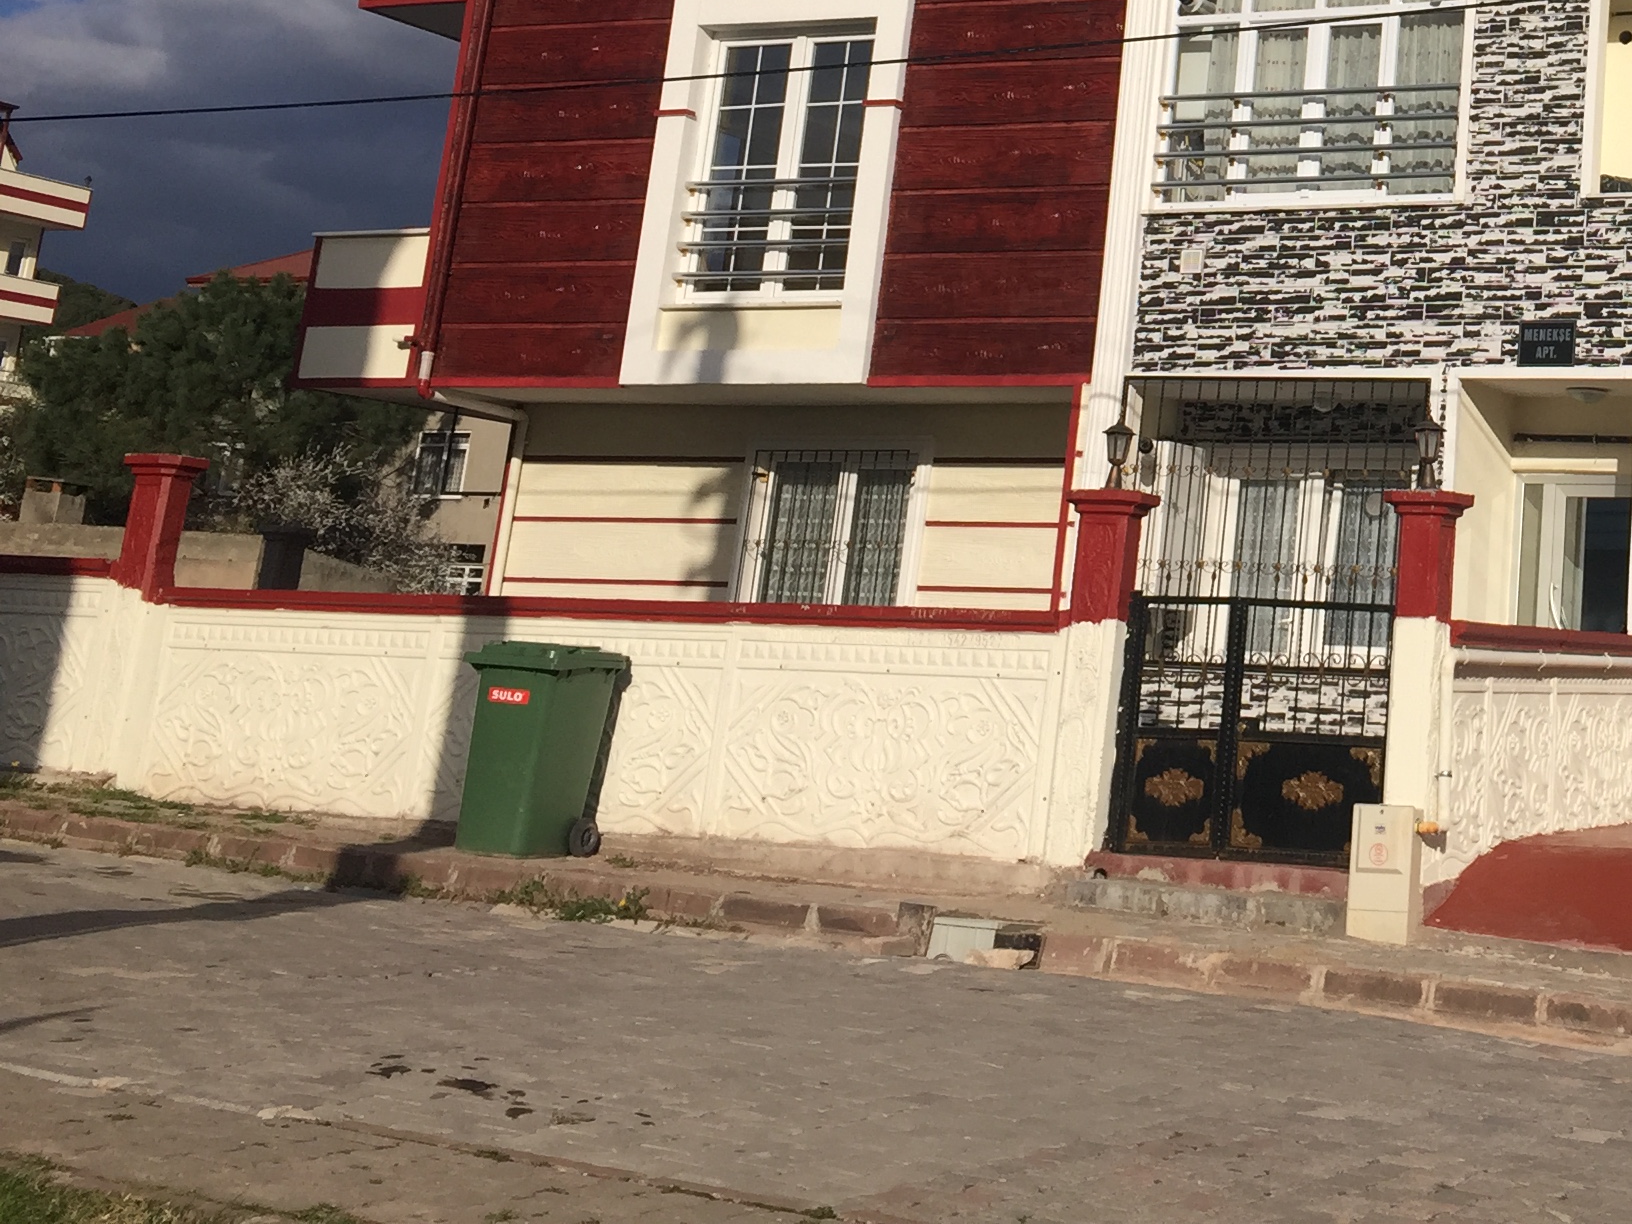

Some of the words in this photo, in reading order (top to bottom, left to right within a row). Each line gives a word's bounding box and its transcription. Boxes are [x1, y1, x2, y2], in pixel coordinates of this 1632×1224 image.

[1524, 328, 1571, 342] MENEKŞE
[1536, 346, 1557, 359] APT.
[492, 689, 524, 702] SULO
